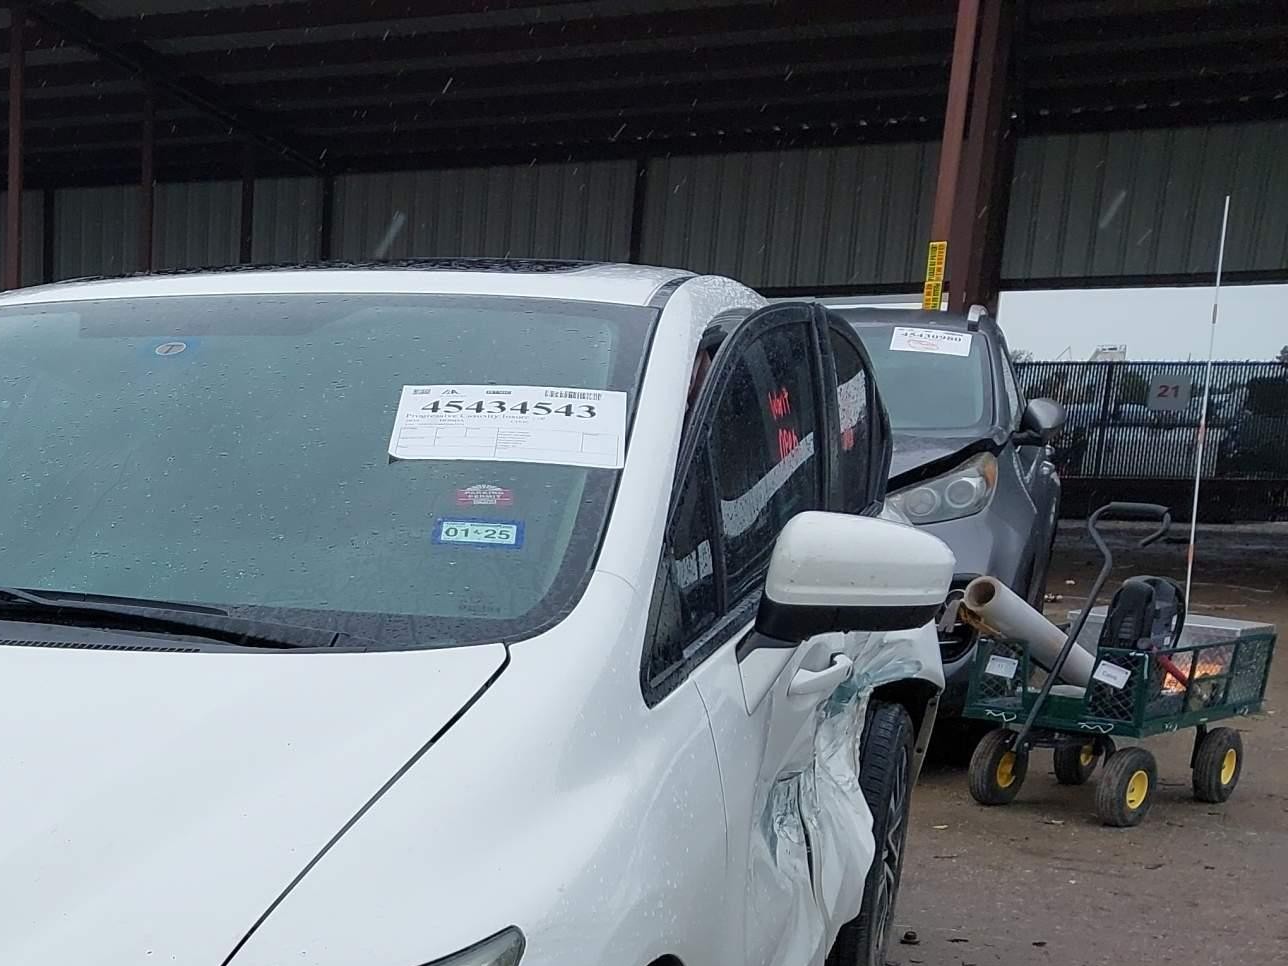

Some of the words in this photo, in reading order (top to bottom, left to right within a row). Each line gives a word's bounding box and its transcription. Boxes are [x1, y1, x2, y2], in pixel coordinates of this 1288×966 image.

[1157, 385, 1180, 398] 21
[421, 400, 597, 419] 45434543
[484, 529, 510, 540] 25
